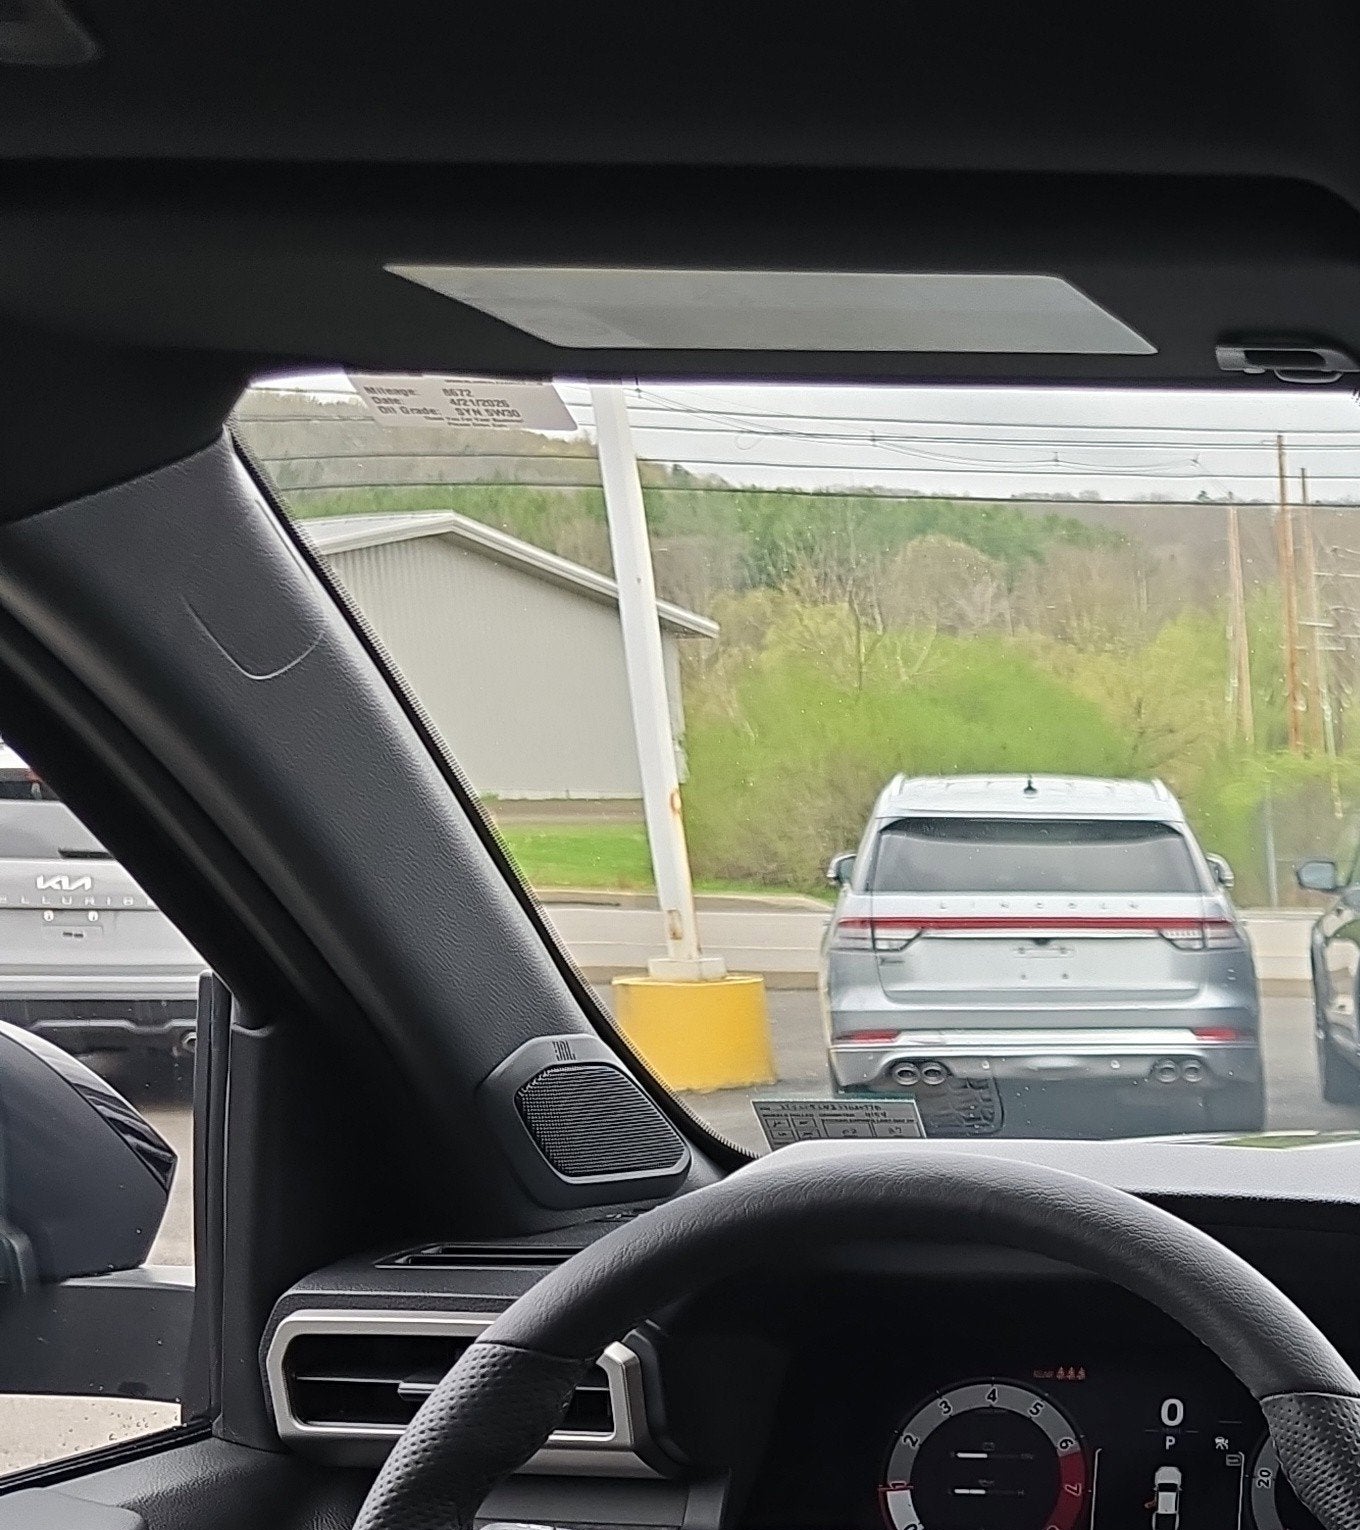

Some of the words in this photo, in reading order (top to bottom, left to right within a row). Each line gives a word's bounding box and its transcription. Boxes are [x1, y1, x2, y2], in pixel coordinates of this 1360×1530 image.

[36, 875, 92, 890] KIA
[986, 1389, 998, 1402] 4
[939, 1400, 952, 1415] 3
[1029, 1401, 1044, 1416] 5
[1161, 1398, 1184, 1426] 0
[902, 1434, 919, 1447] 2
[1058, 1437, 1074, 1450] 6
[1165, 1436, 1176, 1450] P
[1257, 1468, 1272, 1489] 20
[1065, 1483, 1082, 1497] 7
